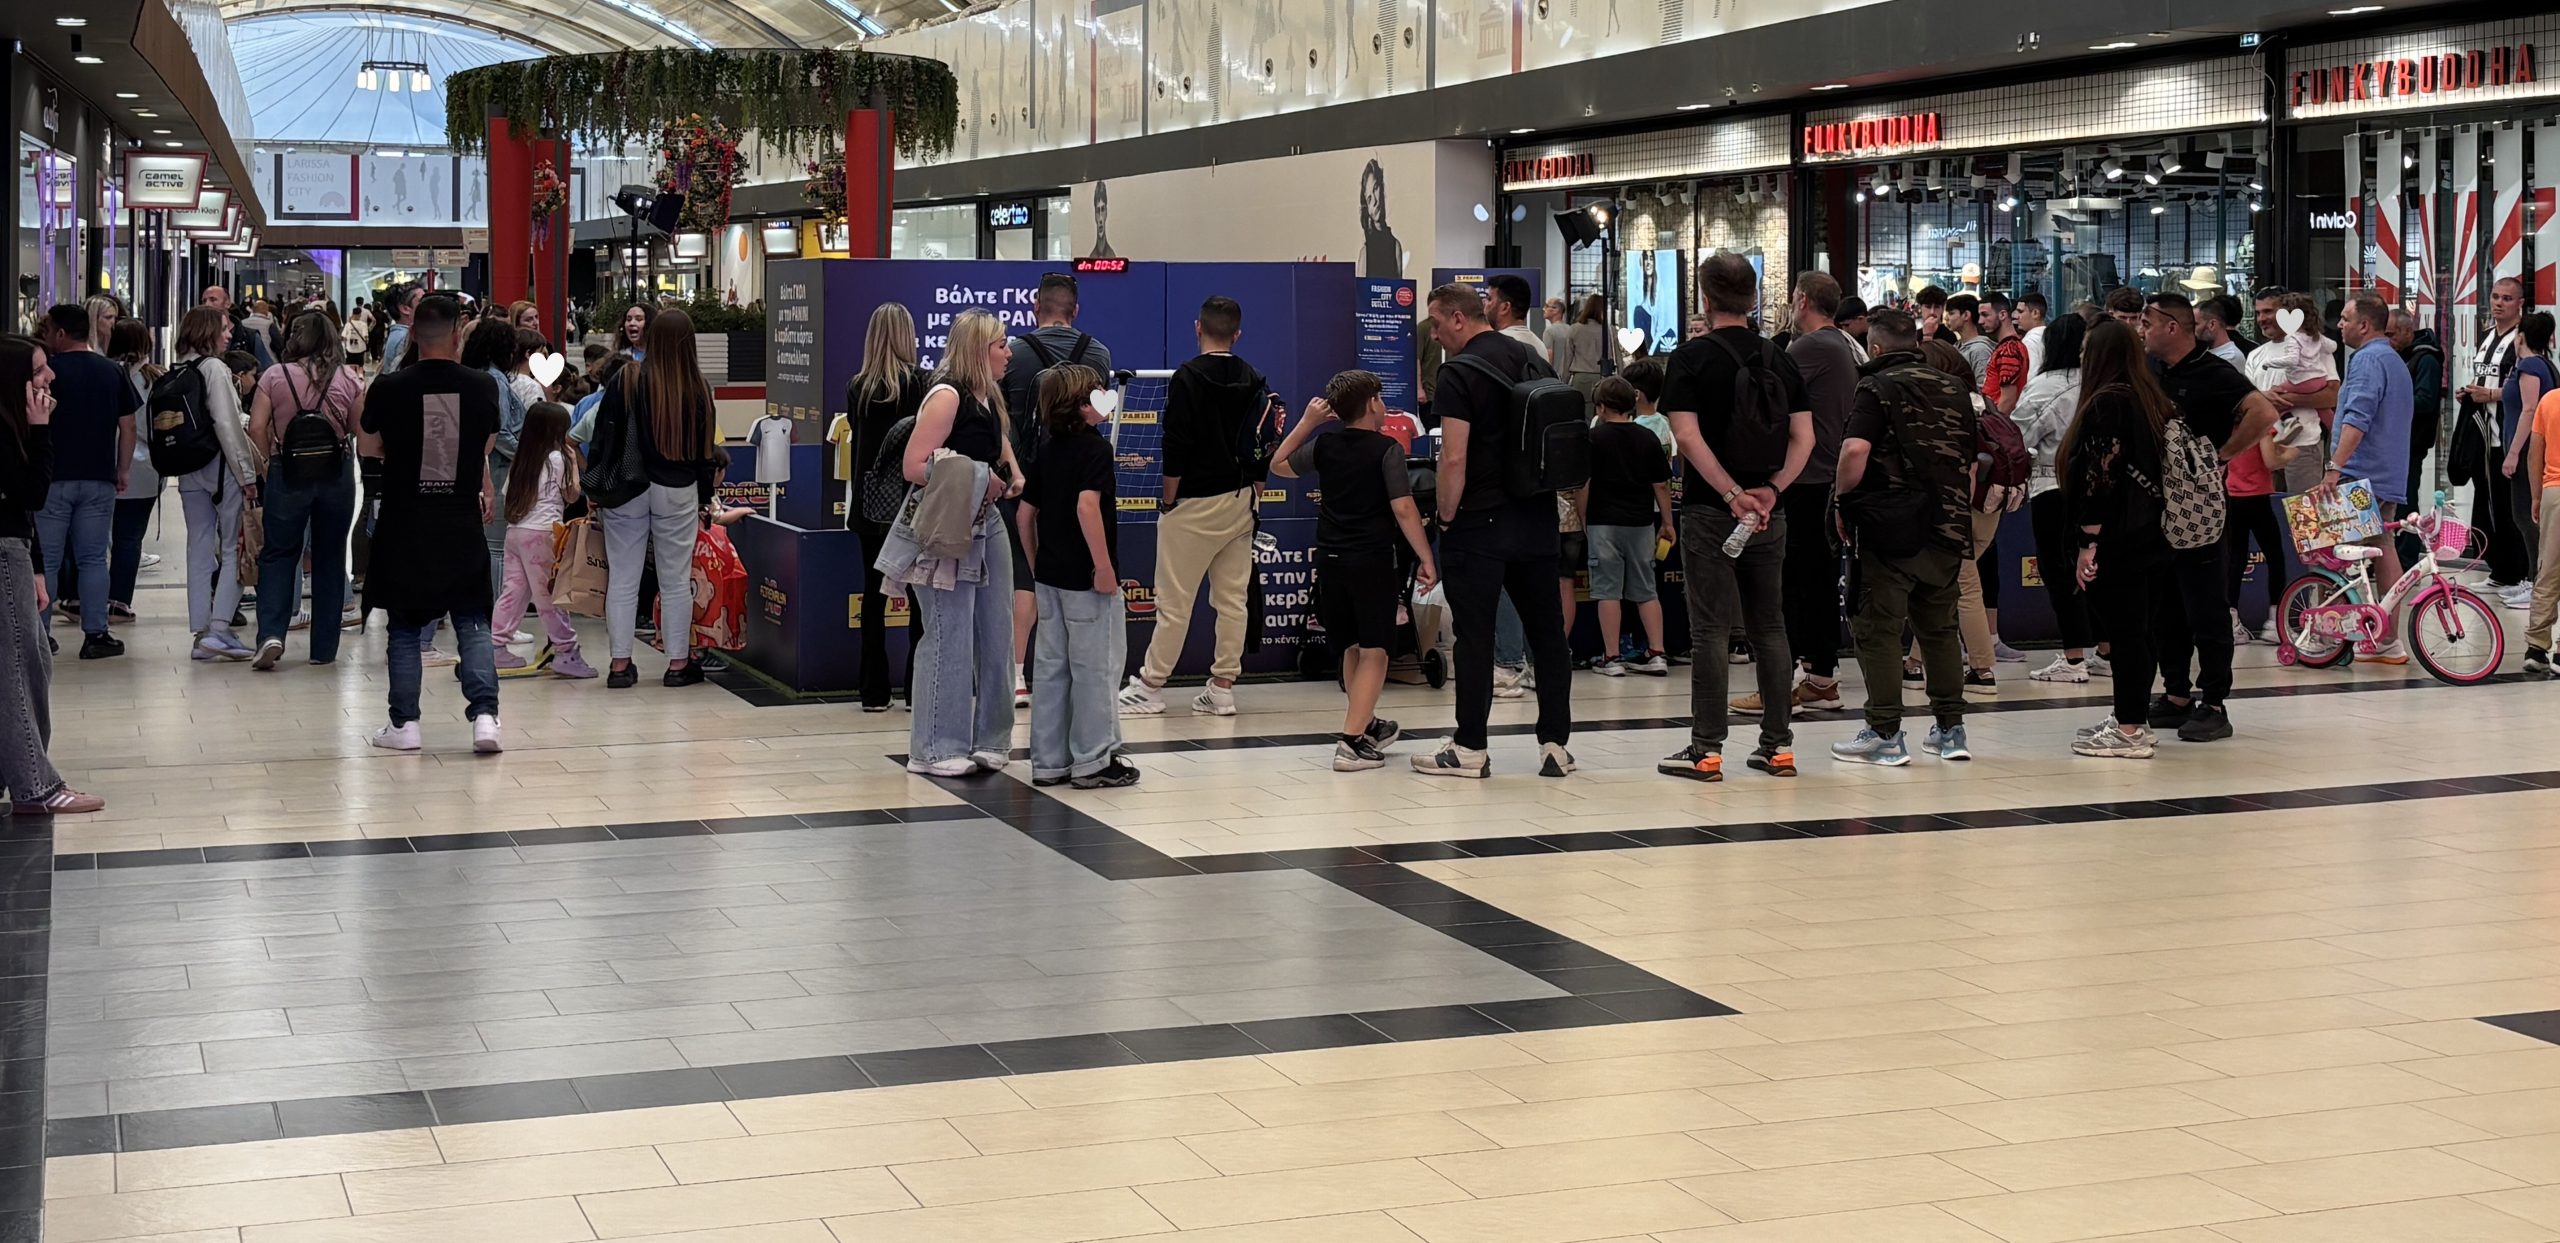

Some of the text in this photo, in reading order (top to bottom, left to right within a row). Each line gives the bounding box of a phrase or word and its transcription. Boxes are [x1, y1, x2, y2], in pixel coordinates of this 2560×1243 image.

[2291, 43, 2537, 107] FUNKYBUDDHA
[1804, 112, 1940, 154] FUNKYBUDDHA
[287, 158, 330, 169] LARISSA
[1503, 153, 1593, 183] FUNKYBUDDHA
[287, 173, 334, 184] FASHION
[287, 187, 312, 197] CITY
[935, 284, 1040, 304] Βάλτε ΓΚΟ
[927, 312, 951, 329] με
[998, 310, 1037, 327] PAN
[920, 354, 935, 371] &
[715, 486, 785, 496] DRENALN
[1272, 572, 1306, 585] την
